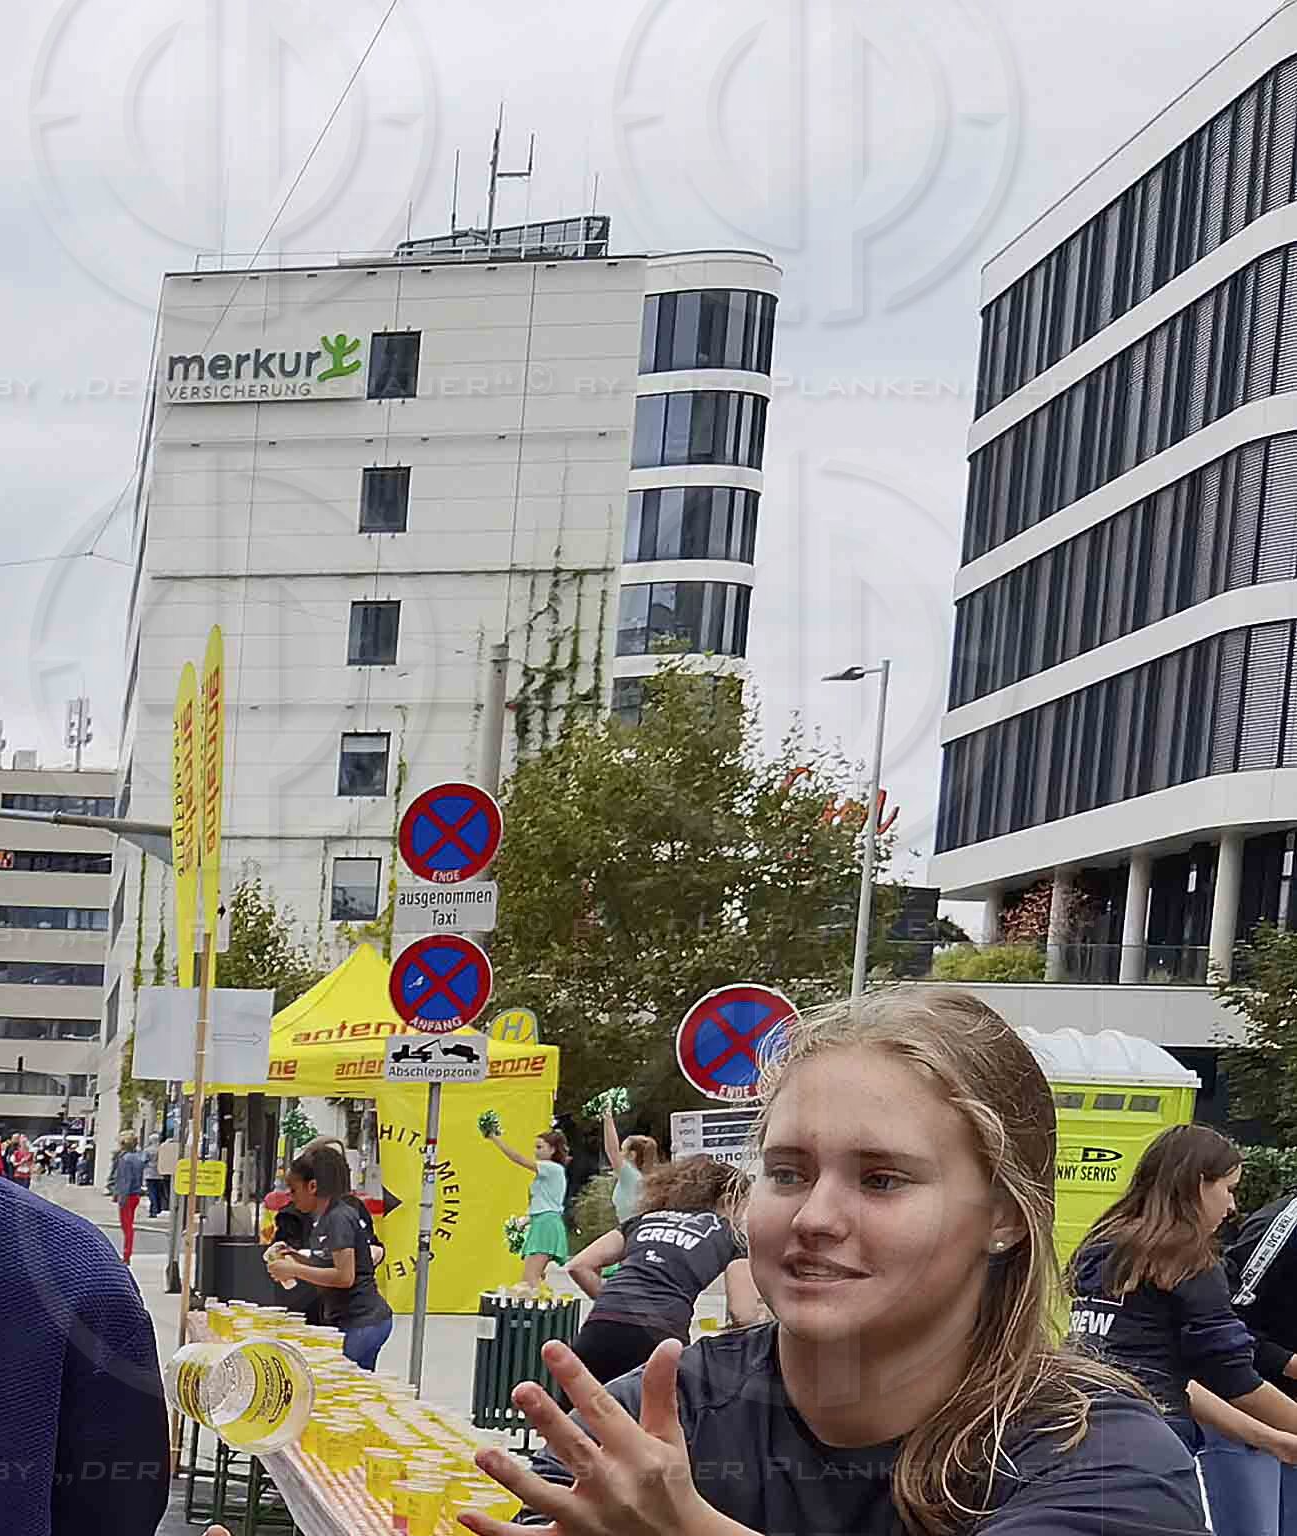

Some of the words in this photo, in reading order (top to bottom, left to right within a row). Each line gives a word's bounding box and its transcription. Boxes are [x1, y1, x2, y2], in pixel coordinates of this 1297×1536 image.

[168, 348, 321, 381] merkur
[166, 383, 311, 400] VERSICHERUNG
[432, 869, 461, 882] ENDE
[398, 889, 493, 908] ausgenommen
[431, 909, 458, 926] Taxi
[408, 1016, 464, 1032] ANFANG
[389, 1064, 480, 1079] Abschleppzone
[488, 1054, 547, 1073] enne
[718, 1085, 750, 1099] ENDE
[1080, 1165, 1117, 1182] SERVIS
[435, 1159, 461, 1241] MEINE
[636, 1227, 703, 1251] CREW
[1069, 1310, 1116, 1336] REW
